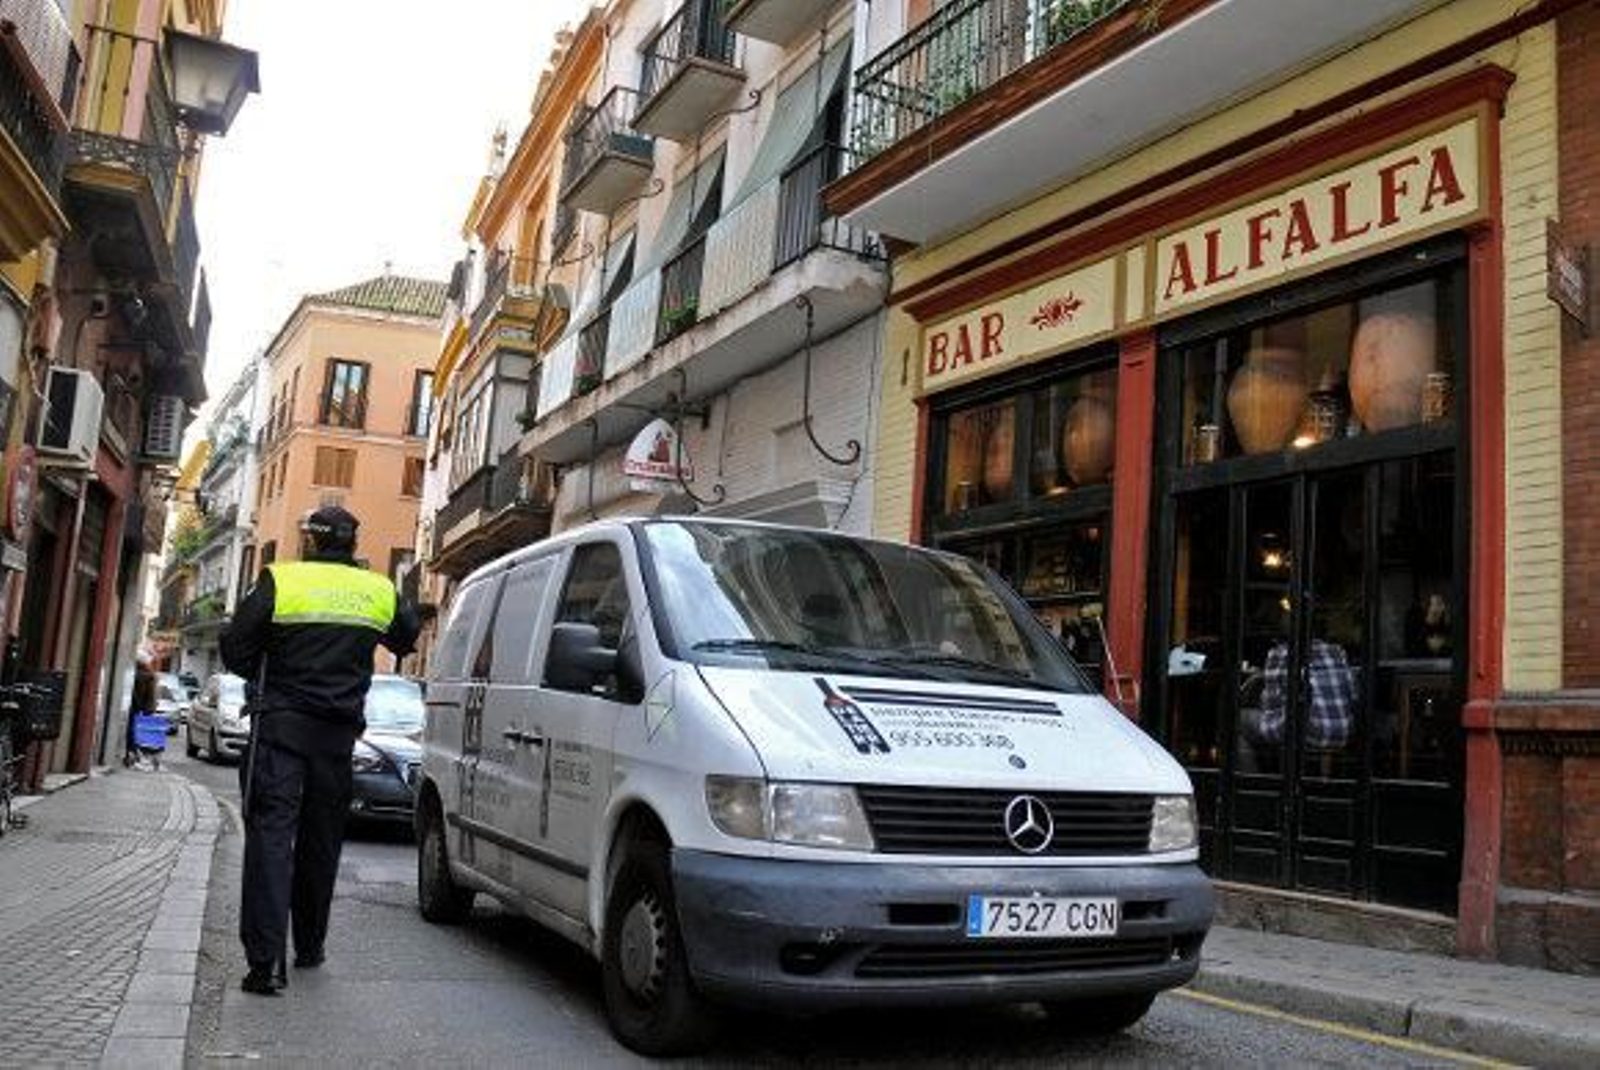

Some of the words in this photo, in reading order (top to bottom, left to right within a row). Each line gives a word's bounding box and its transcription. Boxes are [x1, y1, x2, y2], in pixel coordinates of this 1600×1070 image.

[1163, 144, 1466, 300] ALFALFA
[926, 312, 1005, 377] BAR
[988, 902, 1057, 933] 7527
[1066, 902, 1116, 931] CGN
